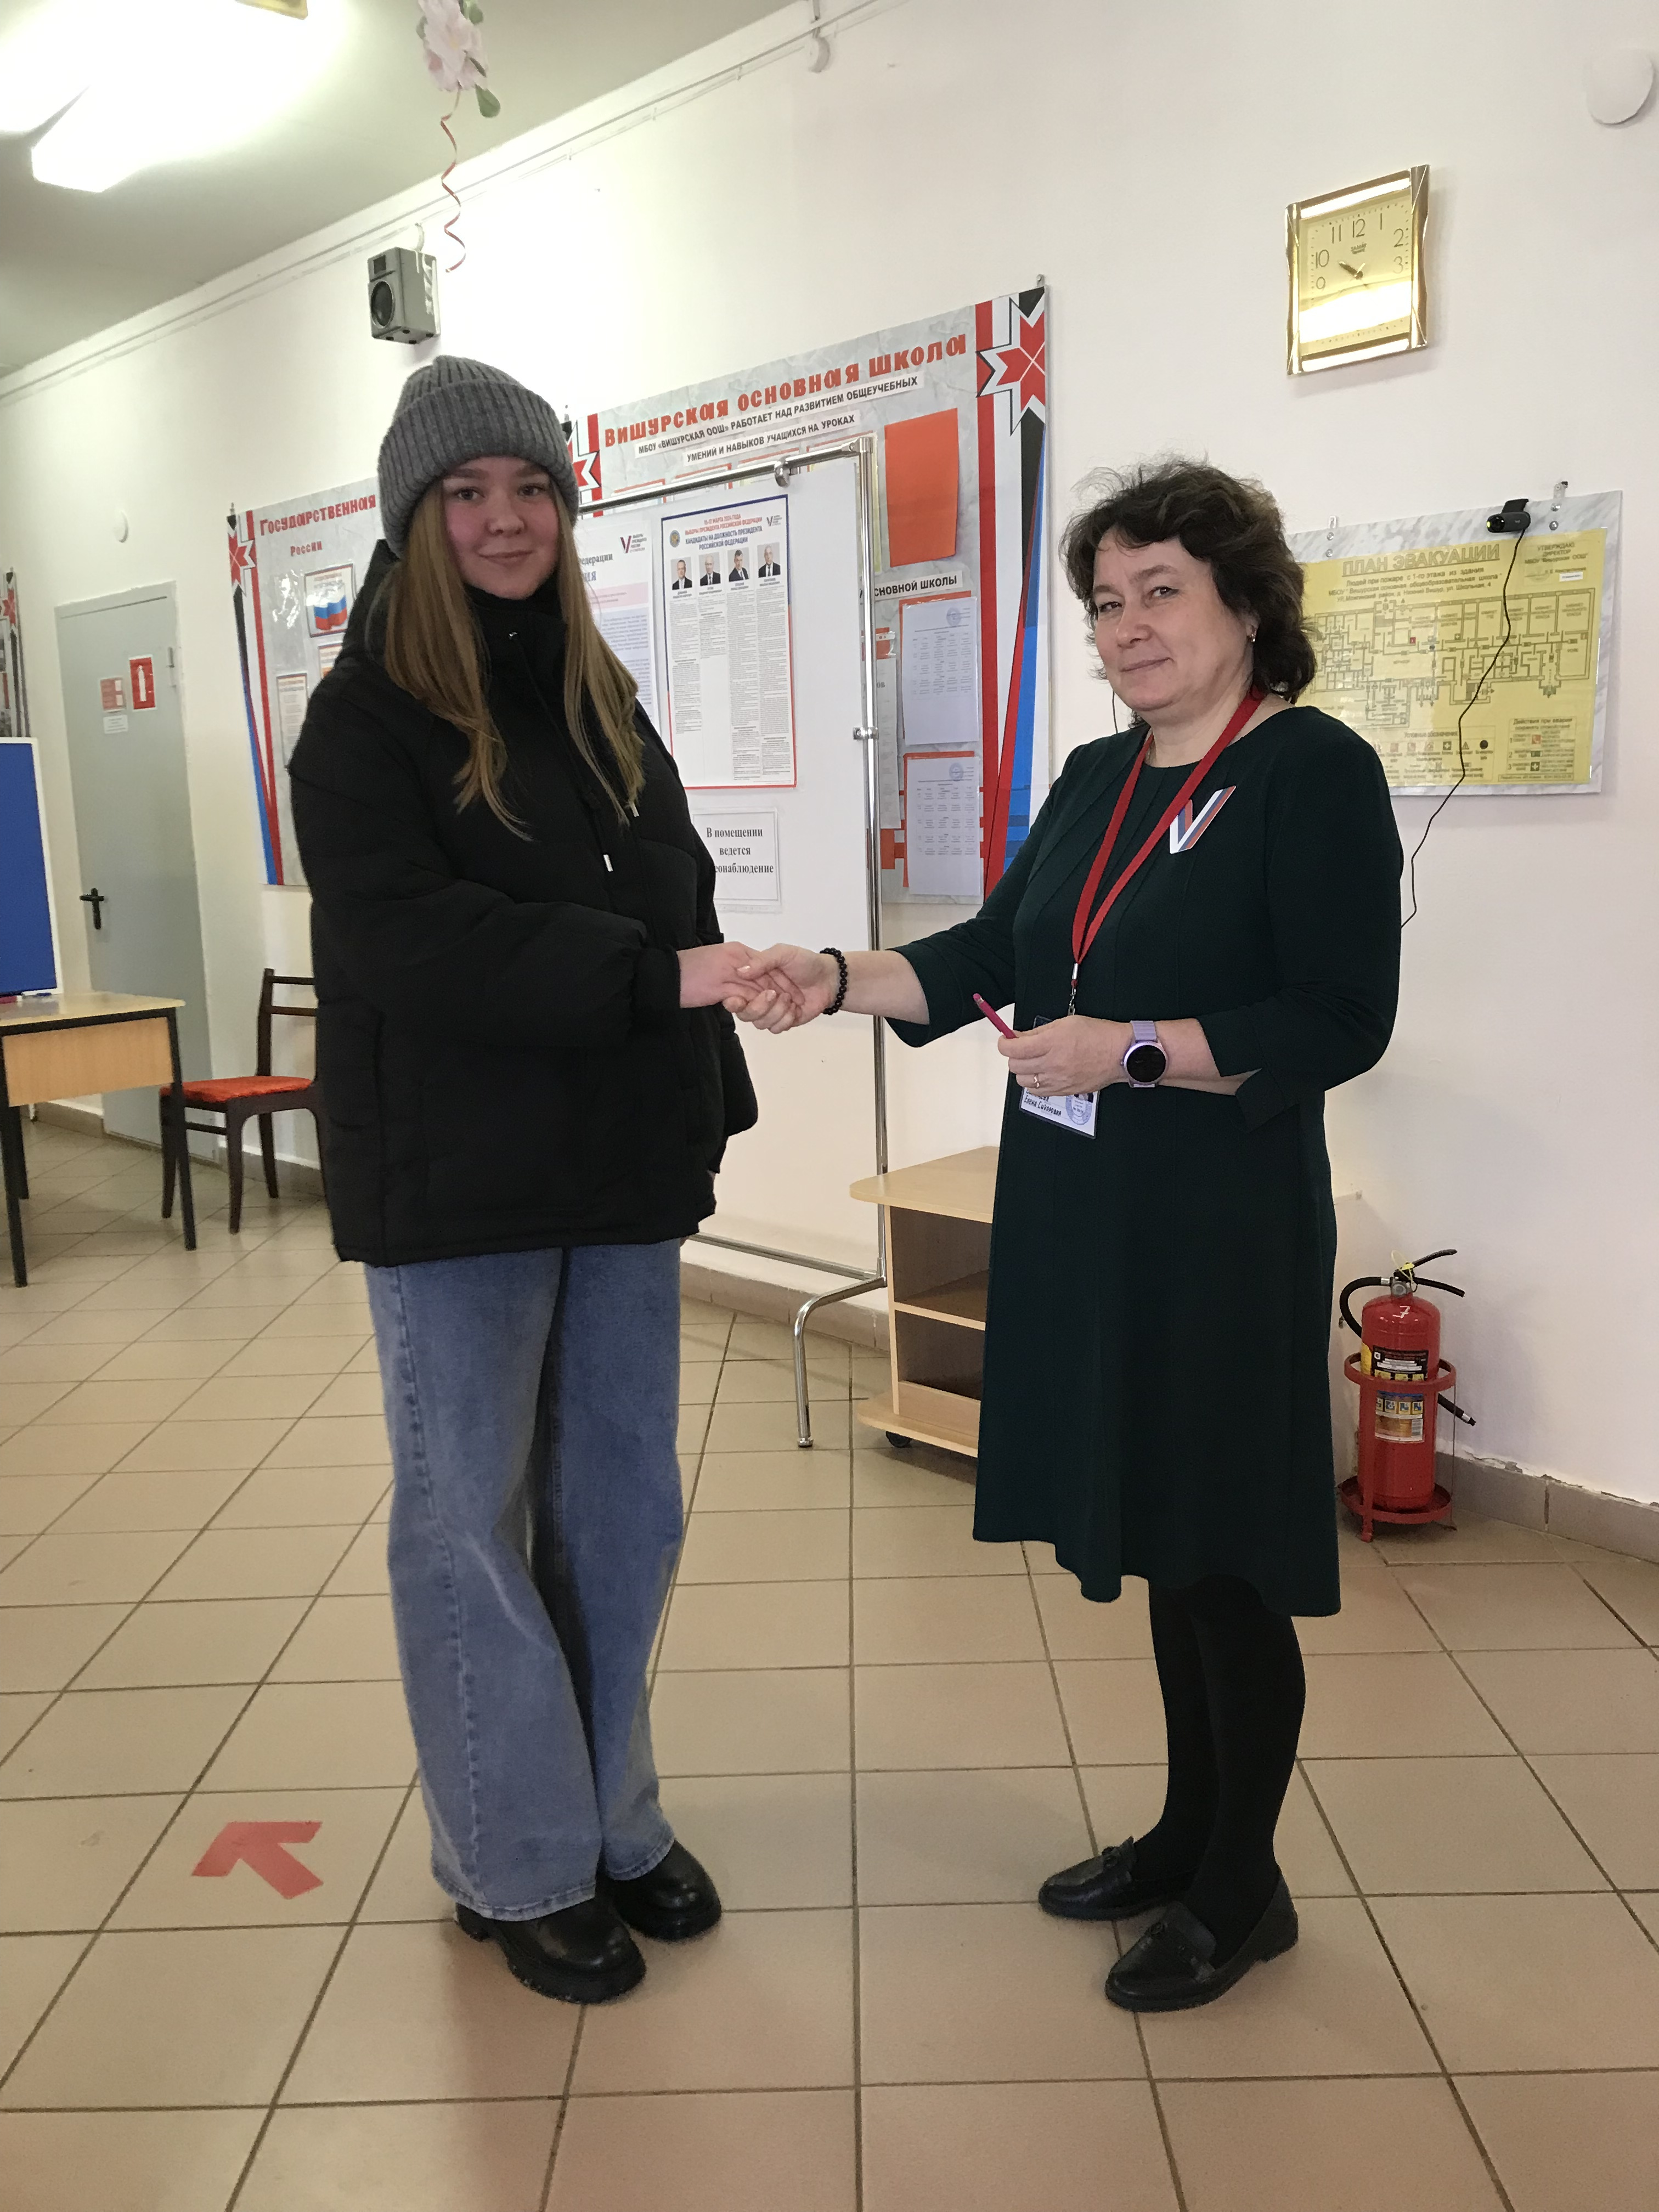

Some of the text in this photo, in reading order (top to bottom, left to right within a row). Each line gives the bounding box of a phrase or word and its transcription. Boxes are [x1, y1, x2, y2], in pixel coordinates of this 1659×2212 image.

[1331, 224, 1342, 244] 11
[1352, 218, 1366, 238] 12
[1393, 228, 1404, 247] 2
[1315, 249, 1330, 269] 10
[1393, 256, 1403, 274] 3
[605, 333, 967, 448] ВИШУРСКАЯ ОСНОВНАЯ ШКОЛА
[638, 376, 918, 454] МБОУ «ВИШУРСКАЯ ООШ» РАБОТАЕТ НАД РАЗВИТИЕМ ОБЩЕУЧЕБНЫХ
[687, 414, 855, 462] УМЕНИЙ И НАВЫКОВ УЧАЩИХСЯ НА УРОКАХ
[738, 526, 763, 535] ПРЕЗИДЕНТА
[724, 537, 748, 546] ФЕДЕРАЦИИ
[1342, 544, 1500, 575] ПЛАН ЭВАКУАЦИИ
[1460, 567, 1484, 575] здания
[874, 580, 918, 597] СНОВНОЙ
[920, 575, 957, 589] ШКОЛЫ
[706, 827, 763, 838] В помещении
[719, 847, 751, 856] ведется
[715, 862, 774, 874] еонаблюдение
